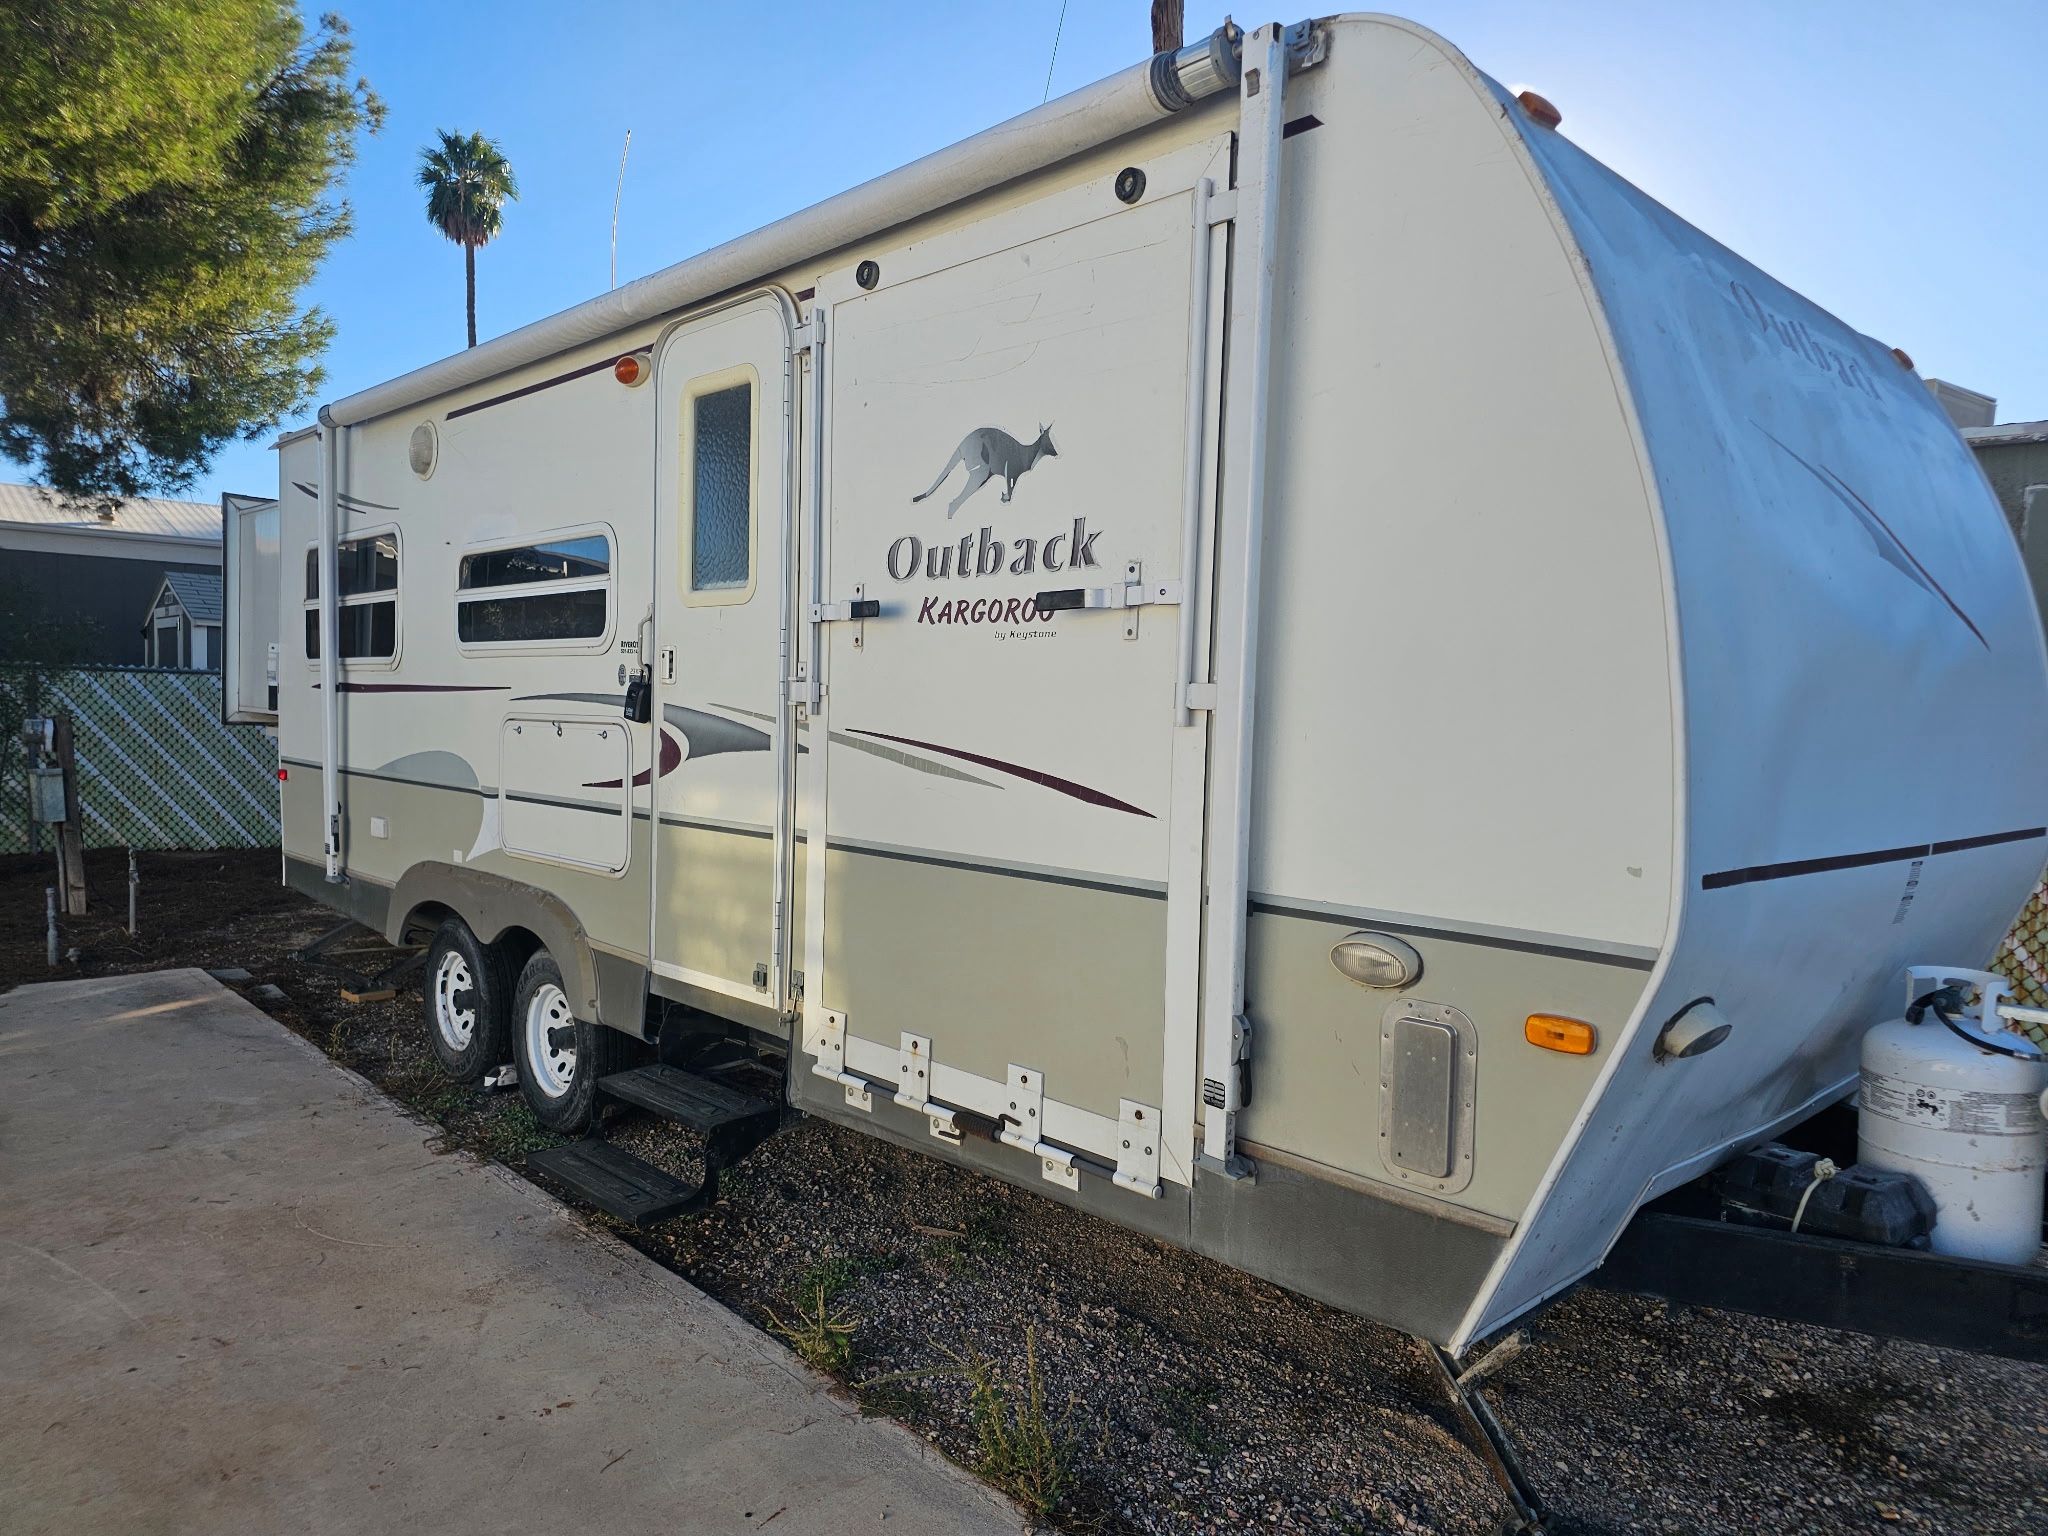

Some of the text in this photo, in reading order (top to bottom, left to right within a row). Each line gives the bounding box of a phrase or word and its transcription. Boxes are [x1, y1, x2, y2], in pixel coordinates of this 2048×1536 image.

[887, 515, 1104, 582] Outback
[994, 630, 1057, 641] by Keystone
